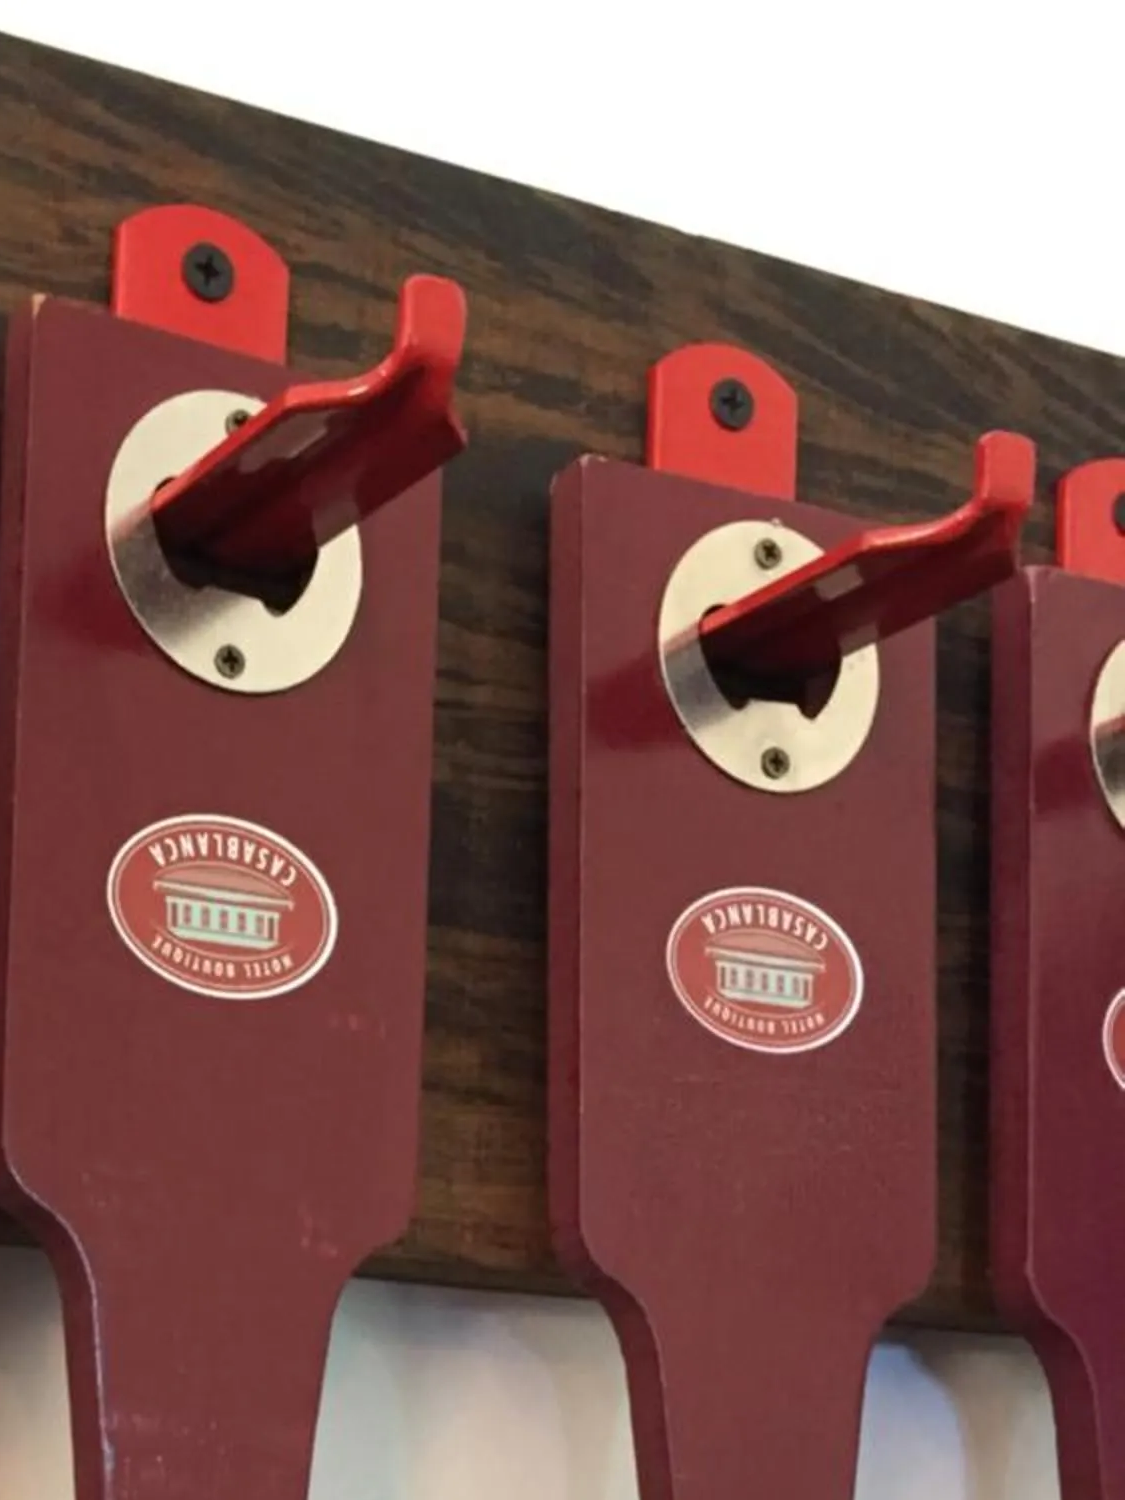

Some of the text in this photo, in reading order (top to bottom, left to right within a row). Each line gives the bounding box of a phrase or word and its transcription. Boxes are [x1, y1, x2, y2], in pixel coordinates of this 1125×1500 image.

[147, 831, 297, 887] CASABLANCA
[700, 902, 828, 951] CASABLANCA
[150, 935, 294, 979] HOTEL BOUTIQUE
